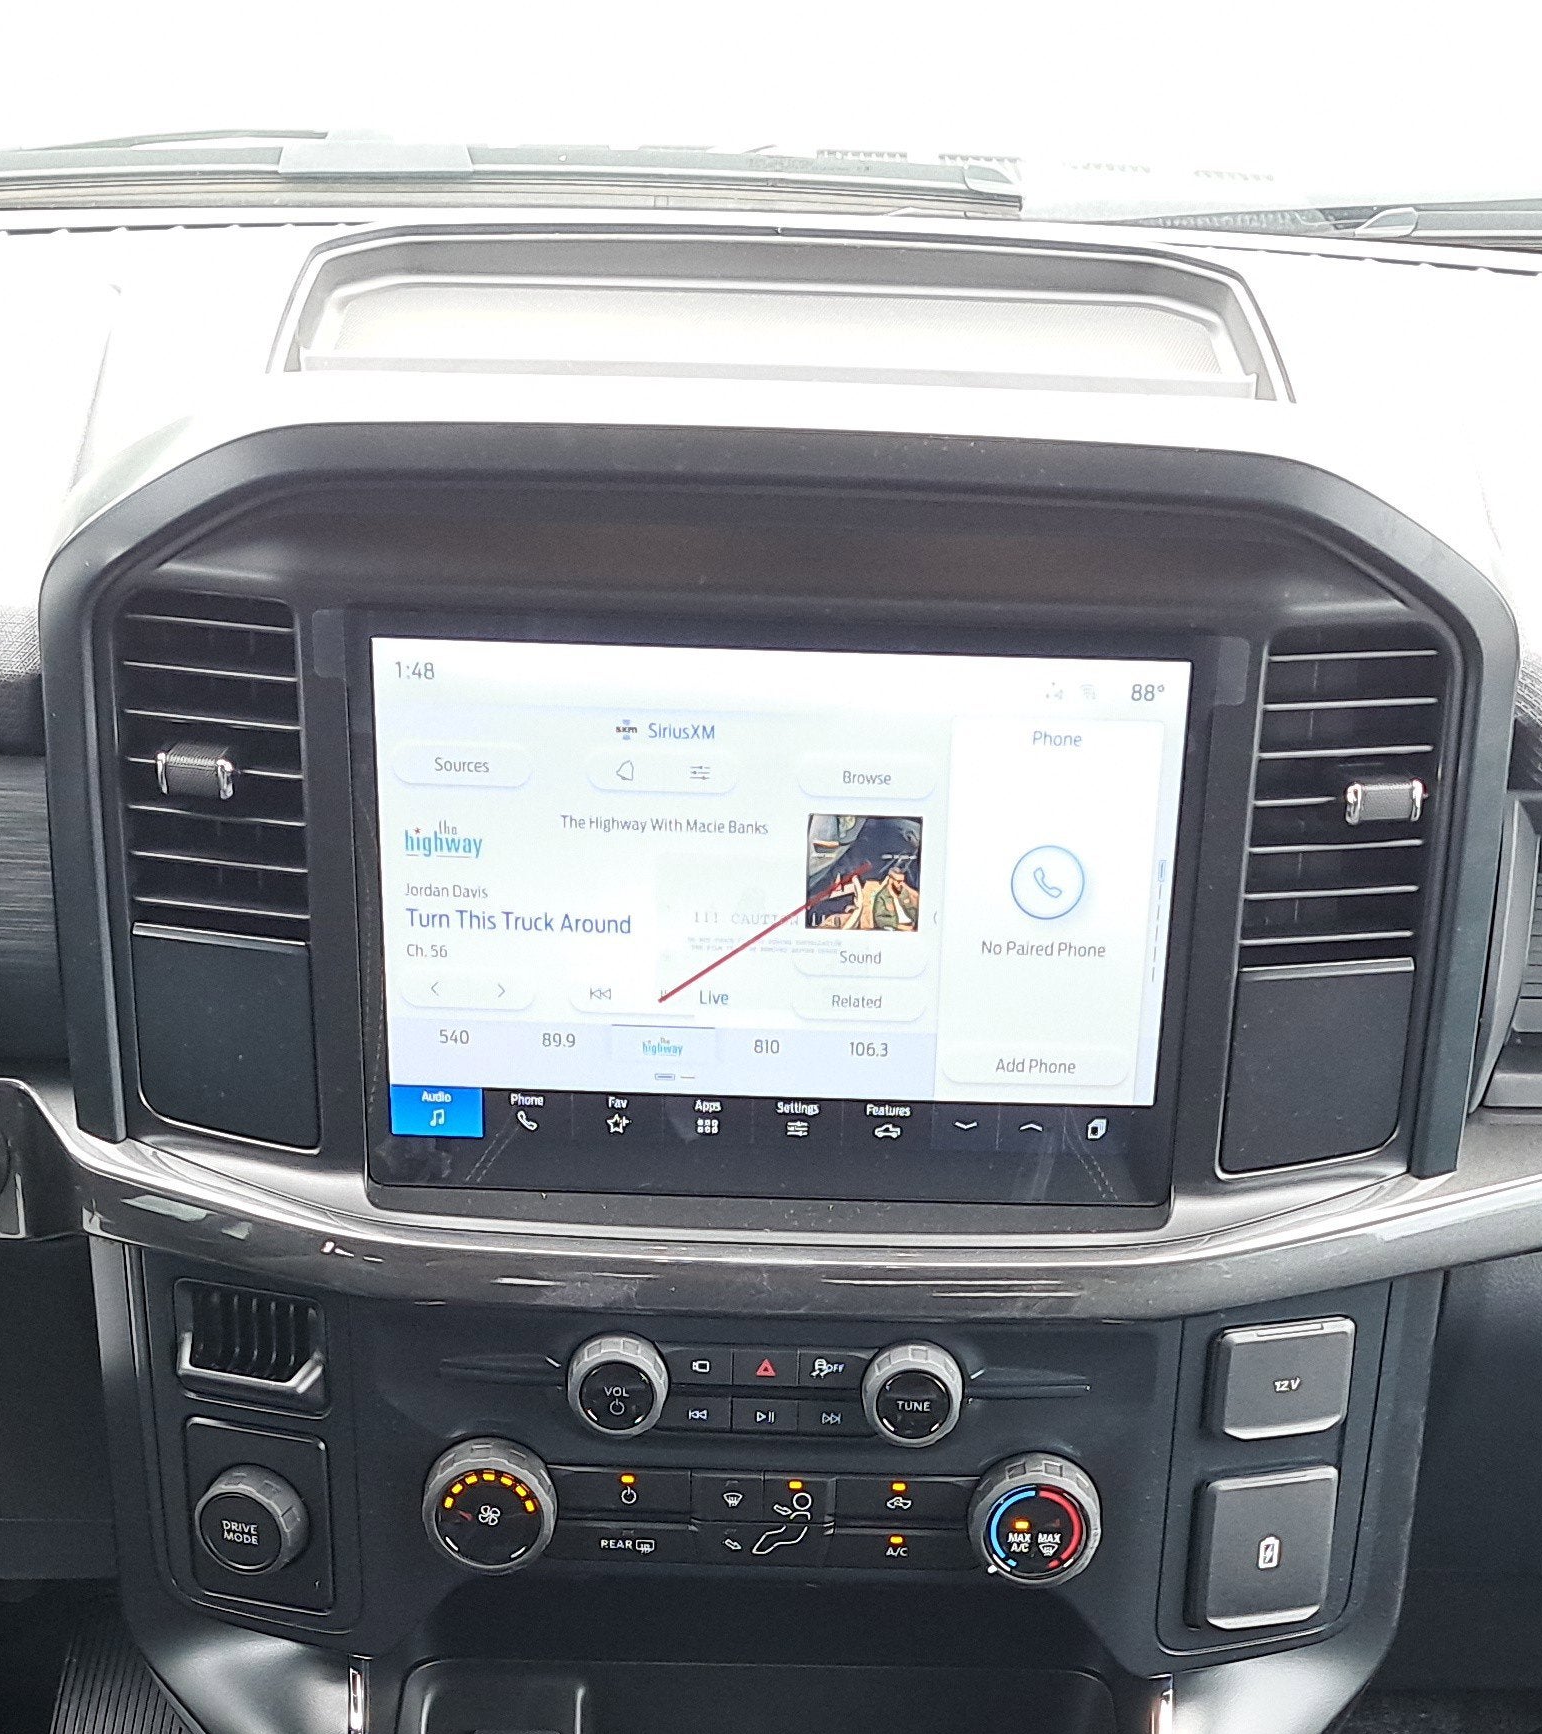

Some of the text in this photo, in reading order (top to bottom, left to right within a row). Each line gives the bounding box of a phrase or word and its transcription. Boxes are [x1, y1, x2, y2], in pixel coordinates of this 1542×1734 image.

[395, 661, 436, 681] 1:48
[648, 722, 715, 741] SiriusXM
[1032, 730, 1083, 747] Phone
[434, 756, 490, 774] Sources
[842, 770, 892, 786] Browse
[438, 820, 458, 836] the
[560, 814, 769, 836] The Highway With Macie Banks
[404, 829, 483, 859] highway
[405, 883, 489, 900] Jordan Davis
[405, 908, 632, 935] Turn This Truck Around
[406, 944, 449, 958] Ch. 56
[981, 940, 1106, 958] No Paired Phone
[839, 950, 882, 966] Sound
[699, 989, 730, 1006] Live
[831, 994, 883, 1009] Related
[439, 1029, 470, 1045] 540
[542, 1032, 576, 1048] 89.9
[753, 1039, 781, 1055] 810
[849, 1042, 889, 1058] 106.3
[995, 1058, 1076, 1075] Add Phone
[421, 1091, 452, 1104] Audio
[510, 1093, 545, 1107] Phone
[608, 1096, 628, 1109] Fav
[694, 1100, 722, 1114] Apps
[776, 1102, 820, 1117] Settings
[865, 1104, 911, 1118] Features
[826, 1361, 846, 1375] OFF
[603, 1385, 630, 1399] VOL
[896, 1400, 931, 1413] TUNE
[221, 1519, 258, 1535] DRIVE
[223, 1531, 259, 1546] MODE
[600, 1538, 633, 1550] REAR
[1007, 1532, 1032, 1544] MAX
[1037, 1532, 1062, 1544] MAX
[885, 1546, 908, 1558] A/C
[1010, 1543, 1030, 1553] A/C
